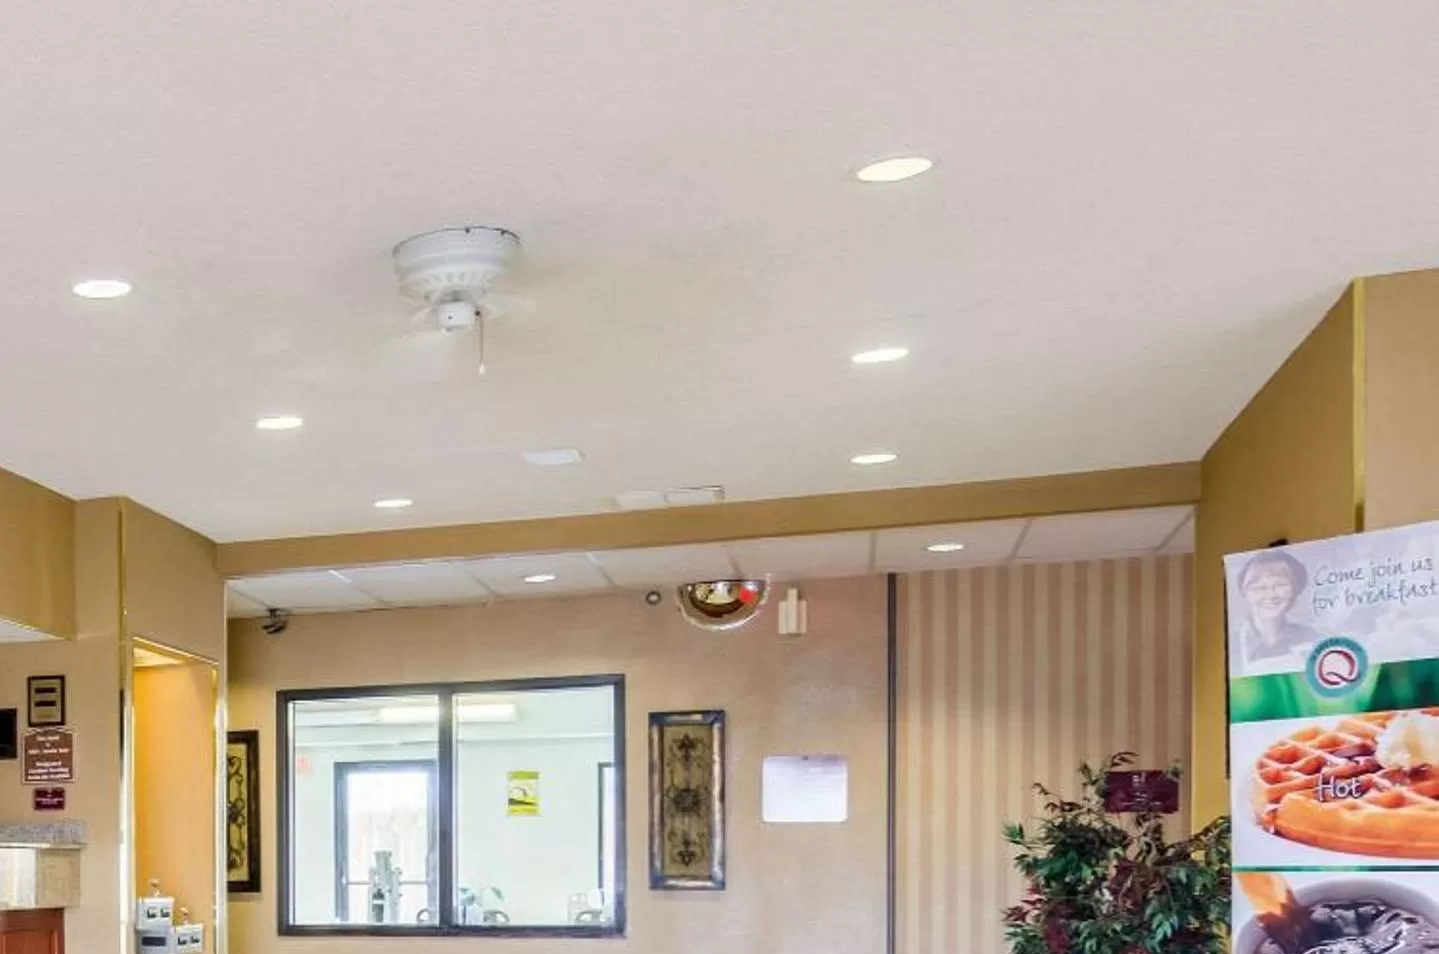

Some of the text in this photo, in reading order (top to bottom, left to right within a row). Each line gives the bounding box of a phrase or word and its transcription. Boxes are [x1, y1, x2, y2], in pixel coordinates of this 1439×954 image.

[1313, 557, 1433, 588] Come join us
[1312, 577, 1439, 616] for breakfast
[1315, 773, 1362, 801] Hot
